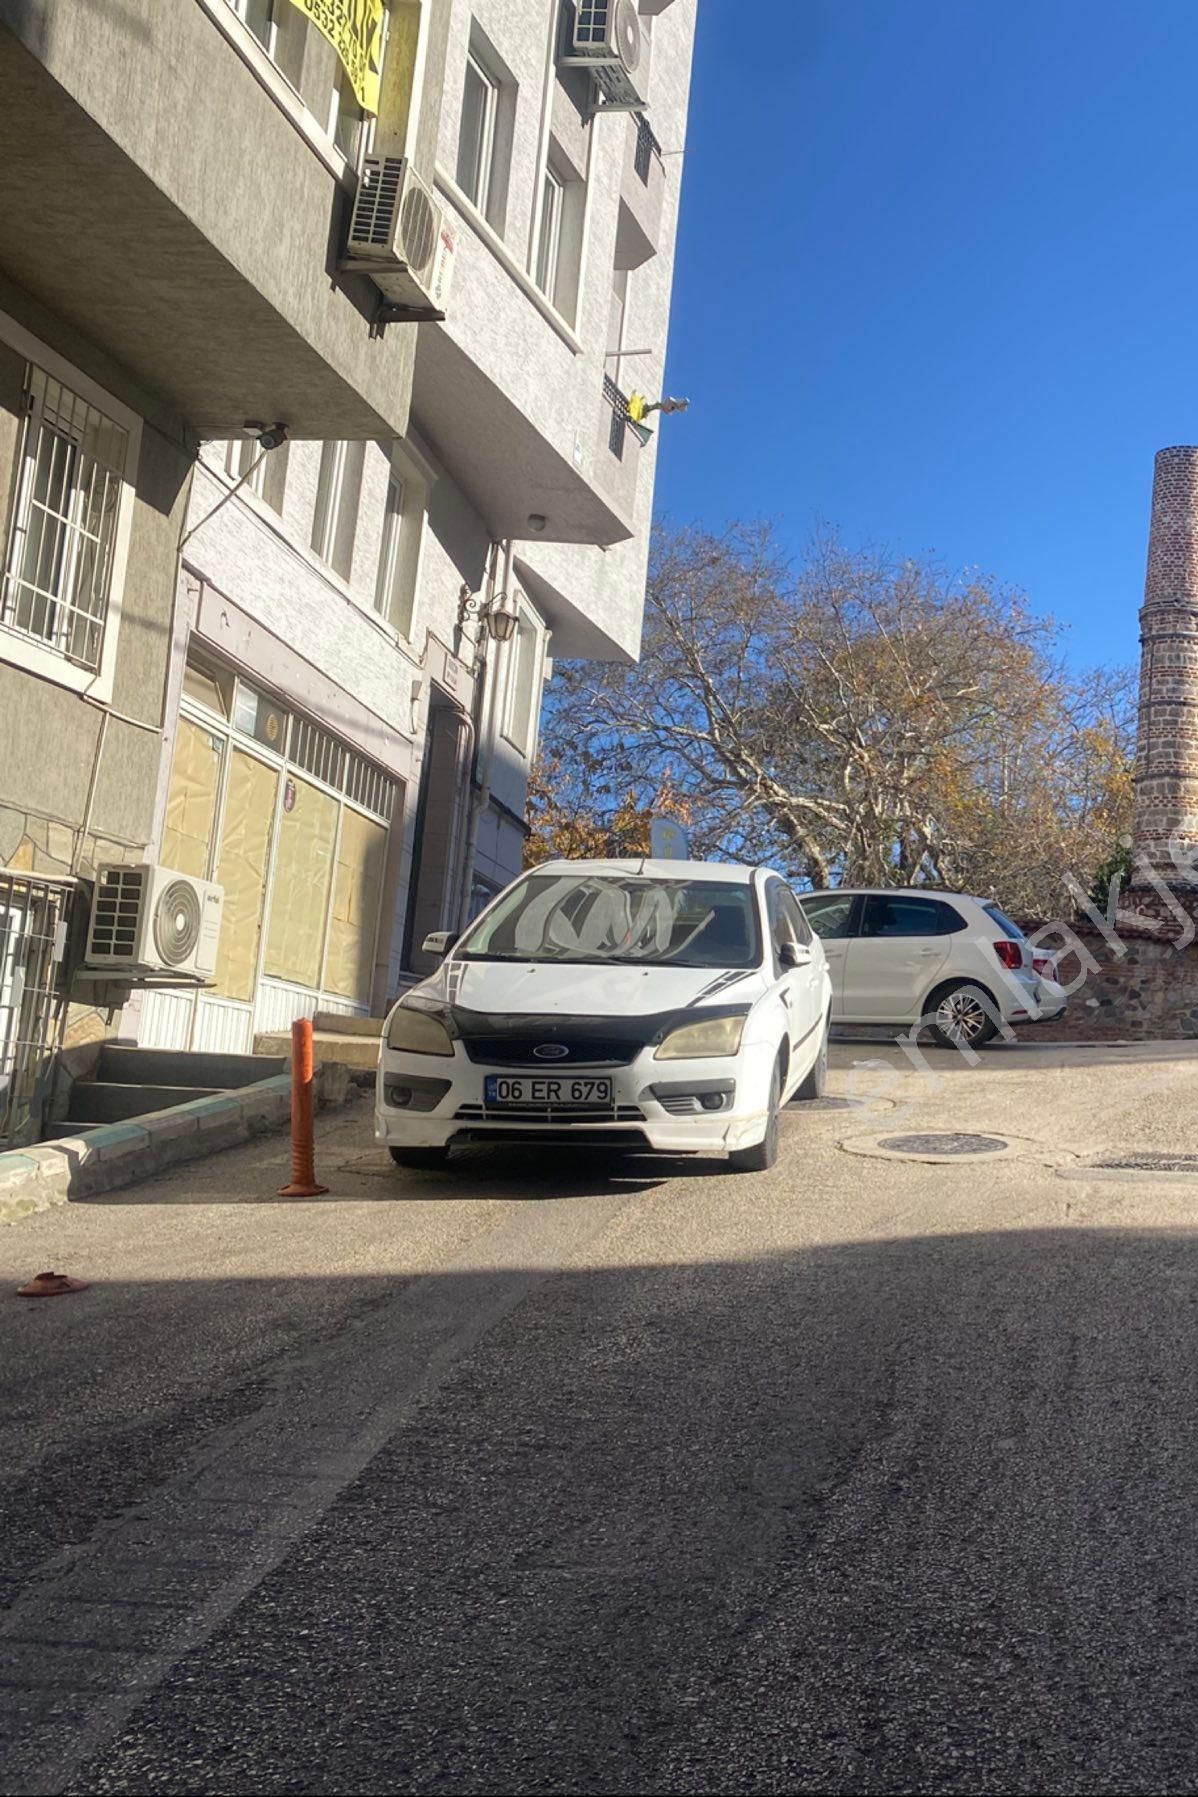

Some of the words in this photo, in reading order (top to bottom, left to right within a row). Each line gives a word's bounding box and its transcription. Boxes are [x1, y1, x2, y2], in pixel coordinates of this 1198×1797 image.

[498, 1080, 522, 1099] 06
[531, 1081, 561, 1100] ER
[571, 1081, 608, 1100] 679
